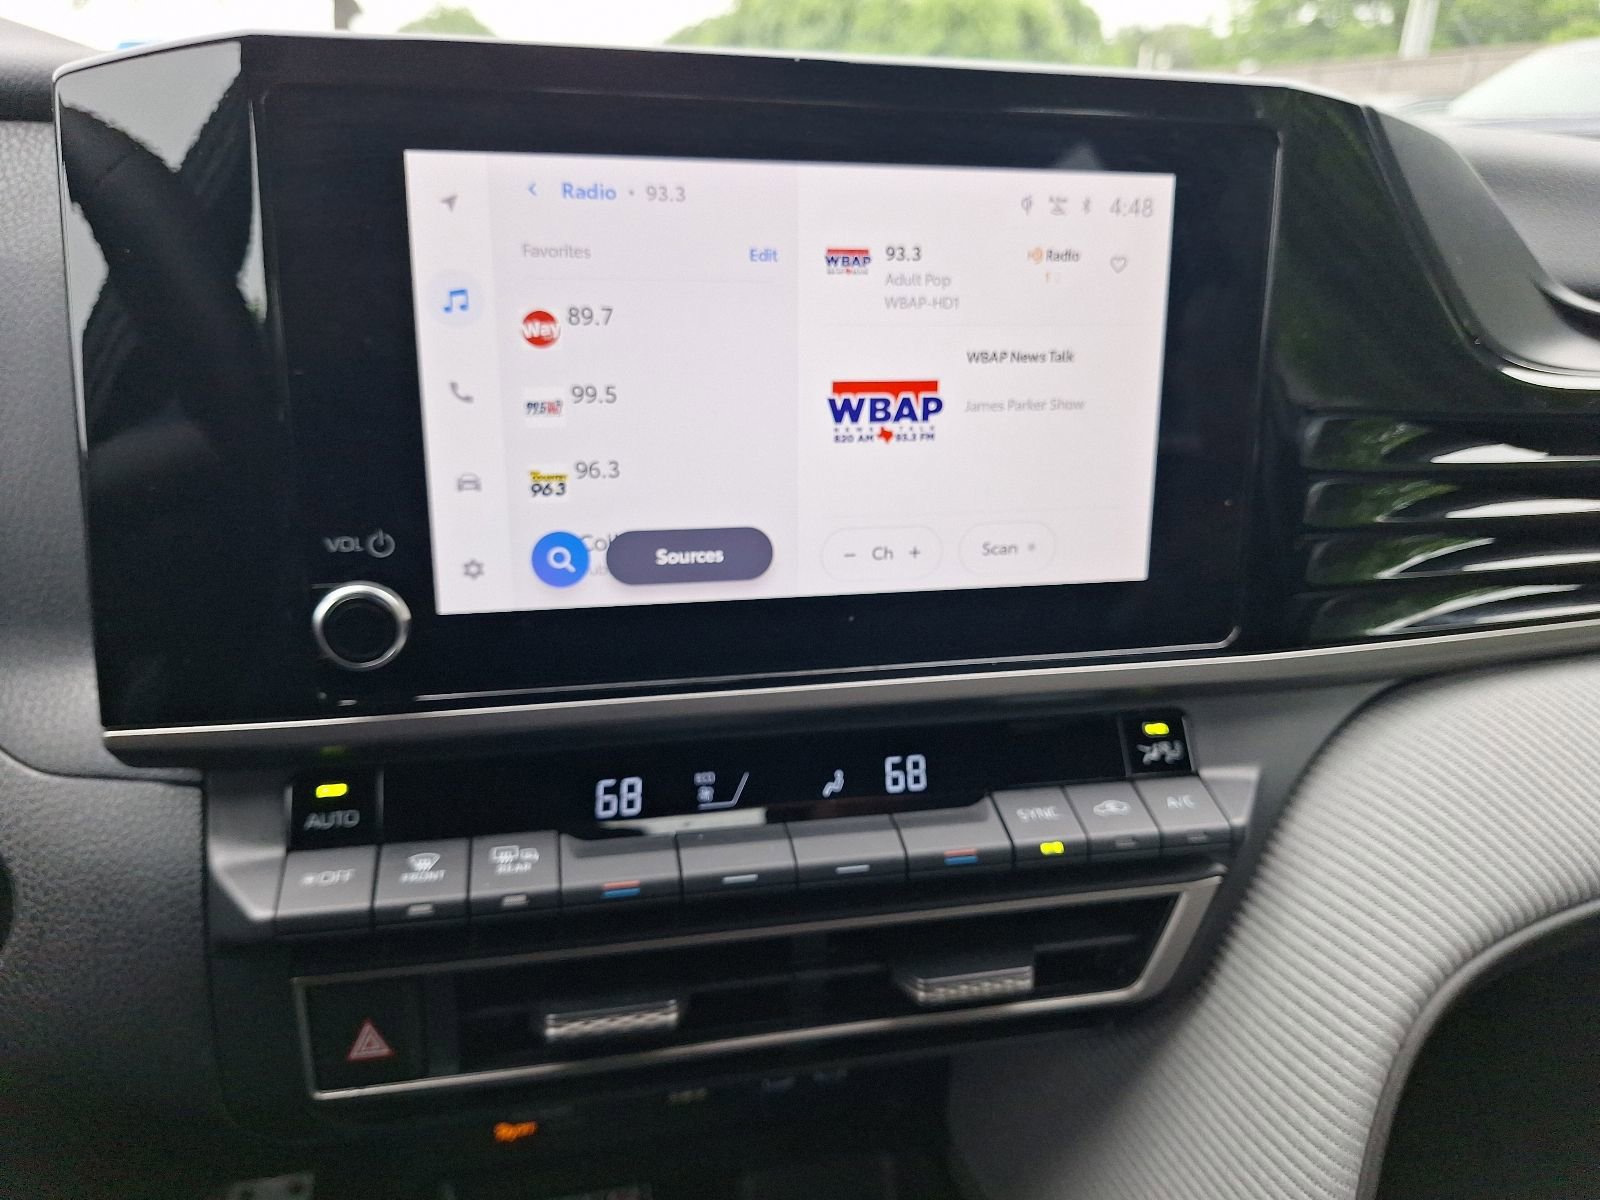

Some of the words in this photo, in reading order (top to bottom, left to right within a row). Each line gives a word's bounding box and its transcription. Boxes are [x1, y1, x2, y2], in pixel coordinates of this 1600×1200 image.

[561, 182, 617, 201] Radio
[646, 185, 686, 202] 93.3
[1109, 197, 1154, 218] 4:48
[521, 243, 591, 260] Favorites
[749, 247, 778, 263] Edit
[885, 246, 921, 262] 93.3
[1045, 248, 1080, 263] Radio
[825, 255, 871, 267] WBAP
[884, 273, 920, 287] Adult
[924, 273, 952, 290] Pop
[567, 307, 614, 326] 89.7
[966, 351, 1008, 364] WBAP
[1010, 350, 1046, 363] News
[1049, 348, 1074, 362] Talk
[571, 386, 617, 404] 99.5
[827, 396, 943, 424] WBAP
[965, 399, 1005, 412] James
[1006, 398, 1047, 412] Parker
[1049, 397, 1086, 411] Show
[575, 460, 620, 479] 96.3
[323, 536, 364, 553] VOL
[872, 545, 893, 561] Ch
[981, 541, 1018, 557] Scan
[655, 547, 724, 566] Sources
[884, 753, 927, 794] 68
[594, 776, 643, 820] 68
[304, 809, 361, 831] AUTO
